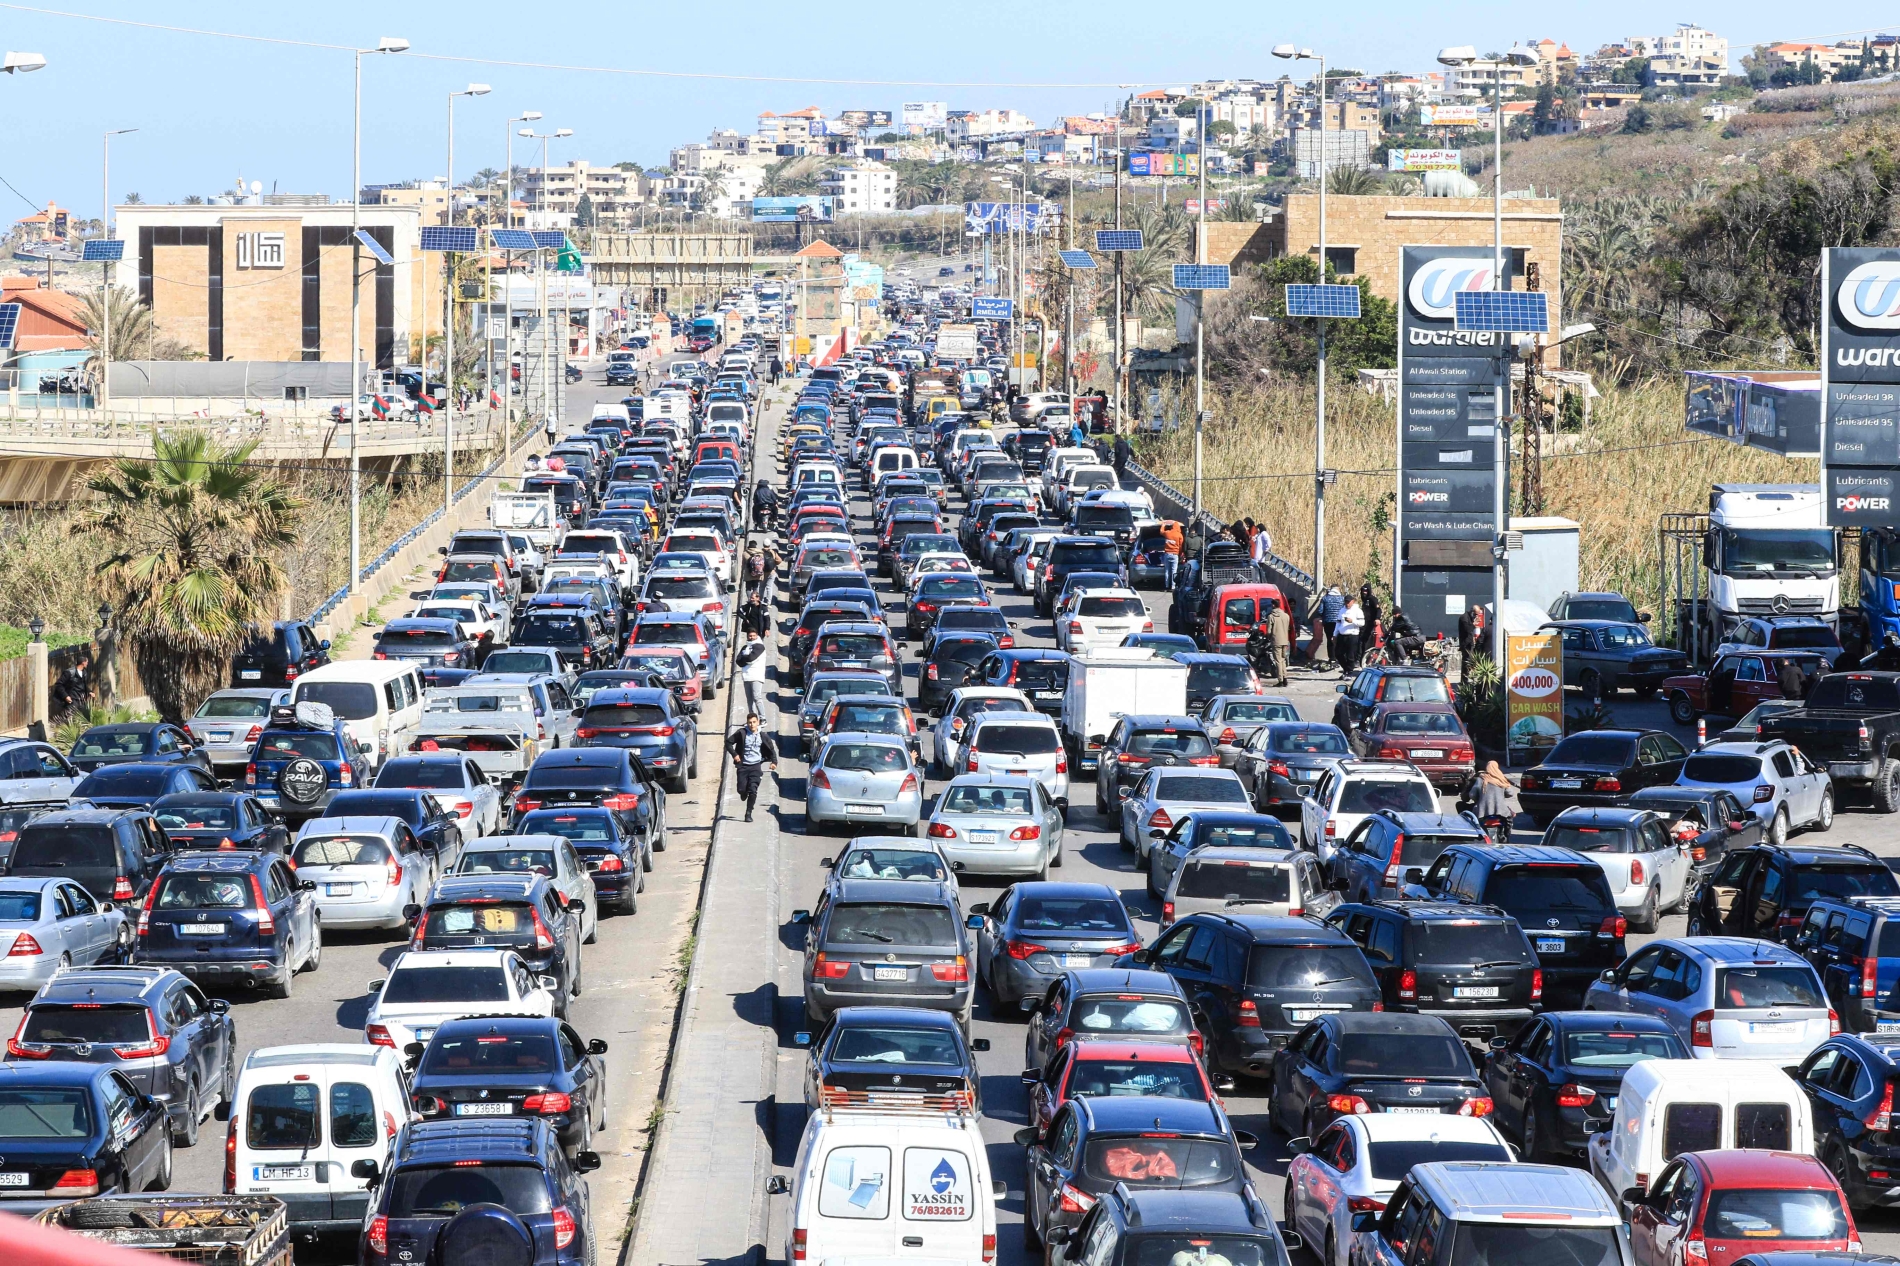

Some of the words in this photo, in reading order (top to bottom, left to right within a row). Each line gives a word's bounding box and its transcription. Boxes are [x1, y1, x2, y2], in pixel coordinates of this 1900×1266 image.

[977, 300, 1007, 309] الرميلة
[1836, 392, 1879, 401] Unleaded
[1881, 393, 1894, 401] 98
[1409, 408, 1445, 416] Unleaded
[1446, 408, 1456, 416] 95
[1835, 417, 1879, 426] Unleaded
[1880, 417, 1893, 426] 95
[1409, 424, 1432, 432] Diesel
[1835, 442, 1863, 451] Diesel
[1836, 476, 1889, 486] Lubricants
[1409, 492, 1448, 502] POWER
[1836, 498, 1889, 509] POWER
[1409, 521, 1422, 529] Car
[1423, 521, 1445, 529] Wash
[1446, 521, 1452, 529] &
[1453, 521, 1472, 529] Lube
[1516, 638, 1553, 651] غسيل
[1513, 655, 1557, 667] سيارات
[1511, 675, 1553, 690] 400,000
[1511, 703, 1531, 713] CAR
[1532, 702, 1560, 713] WASH
[285, 773, 324, 784] RAV4
[970, 834, 996, 842] S173923
[186, 925, 190, 933] N
[195, 925, 220, 933] 107640
[875, 969, 907, 979] G437716
[1459, 988, 1464, 996] N
[1469, 988, 1493, 996] 156230
[464, 1104, 470, 1114] S
[474, 1104, 507, 1114] 236581
[281, 1168, 295, 1178] HF
[297, 1167, 309, 1178] 13
[910, 1205, 965, 1216] 76/832612
